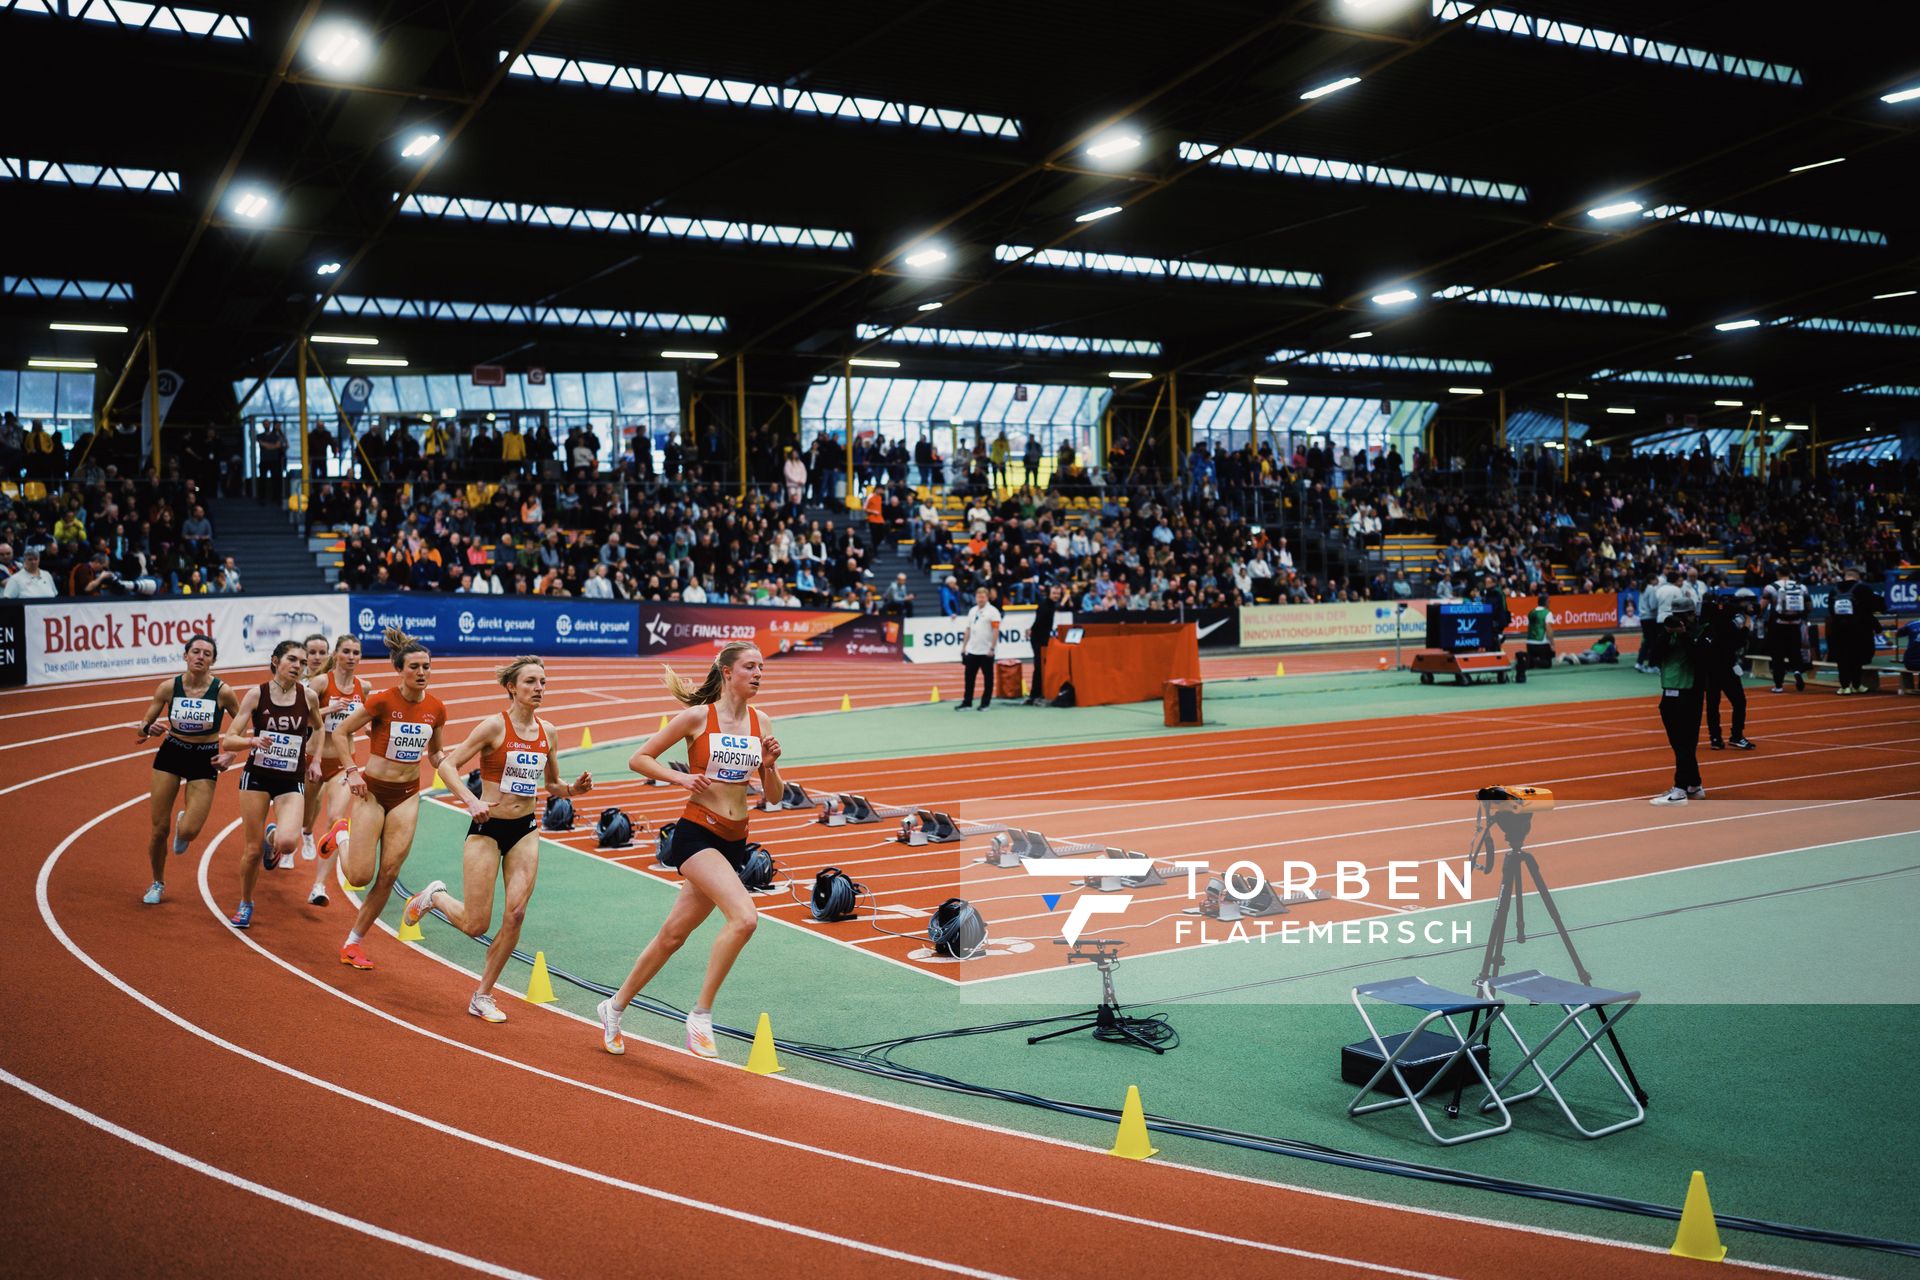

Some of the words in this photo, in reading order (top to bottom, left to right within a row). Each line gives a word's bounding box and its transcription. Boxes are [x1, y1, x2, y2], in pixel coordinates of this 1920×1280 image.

[354, 383, 365, 397] 21
[1890, 584, 1917, 603] GLS
[405, 615, 437, 630] gesund
[1327, 611, 1346, 620] DER
[1565, 610, 1617, 623] Dortmund
[477, 616, 502, 629] direkt
[504, 617, 535, 632] gesund
[574, 619, 598, 631] direkt
[600, 620, 630, 634] gesund
[43, 613, 124, 653] Black
[131, 612, 215, 647] Forest
[674, 624, 690, 637] DIE
[692, 624, 729, 638] FINALS
[731, 626, 756, 639] 2023
[180, 699, 203, 709] GLS
[266, 716, 302, 731] ASV
[400, 724, 422, 735] GLS
[394, 736, 428, 748] GRANZ
[721, 735, 749, 749] GLS
[516, 753, 539, 765] GLS
